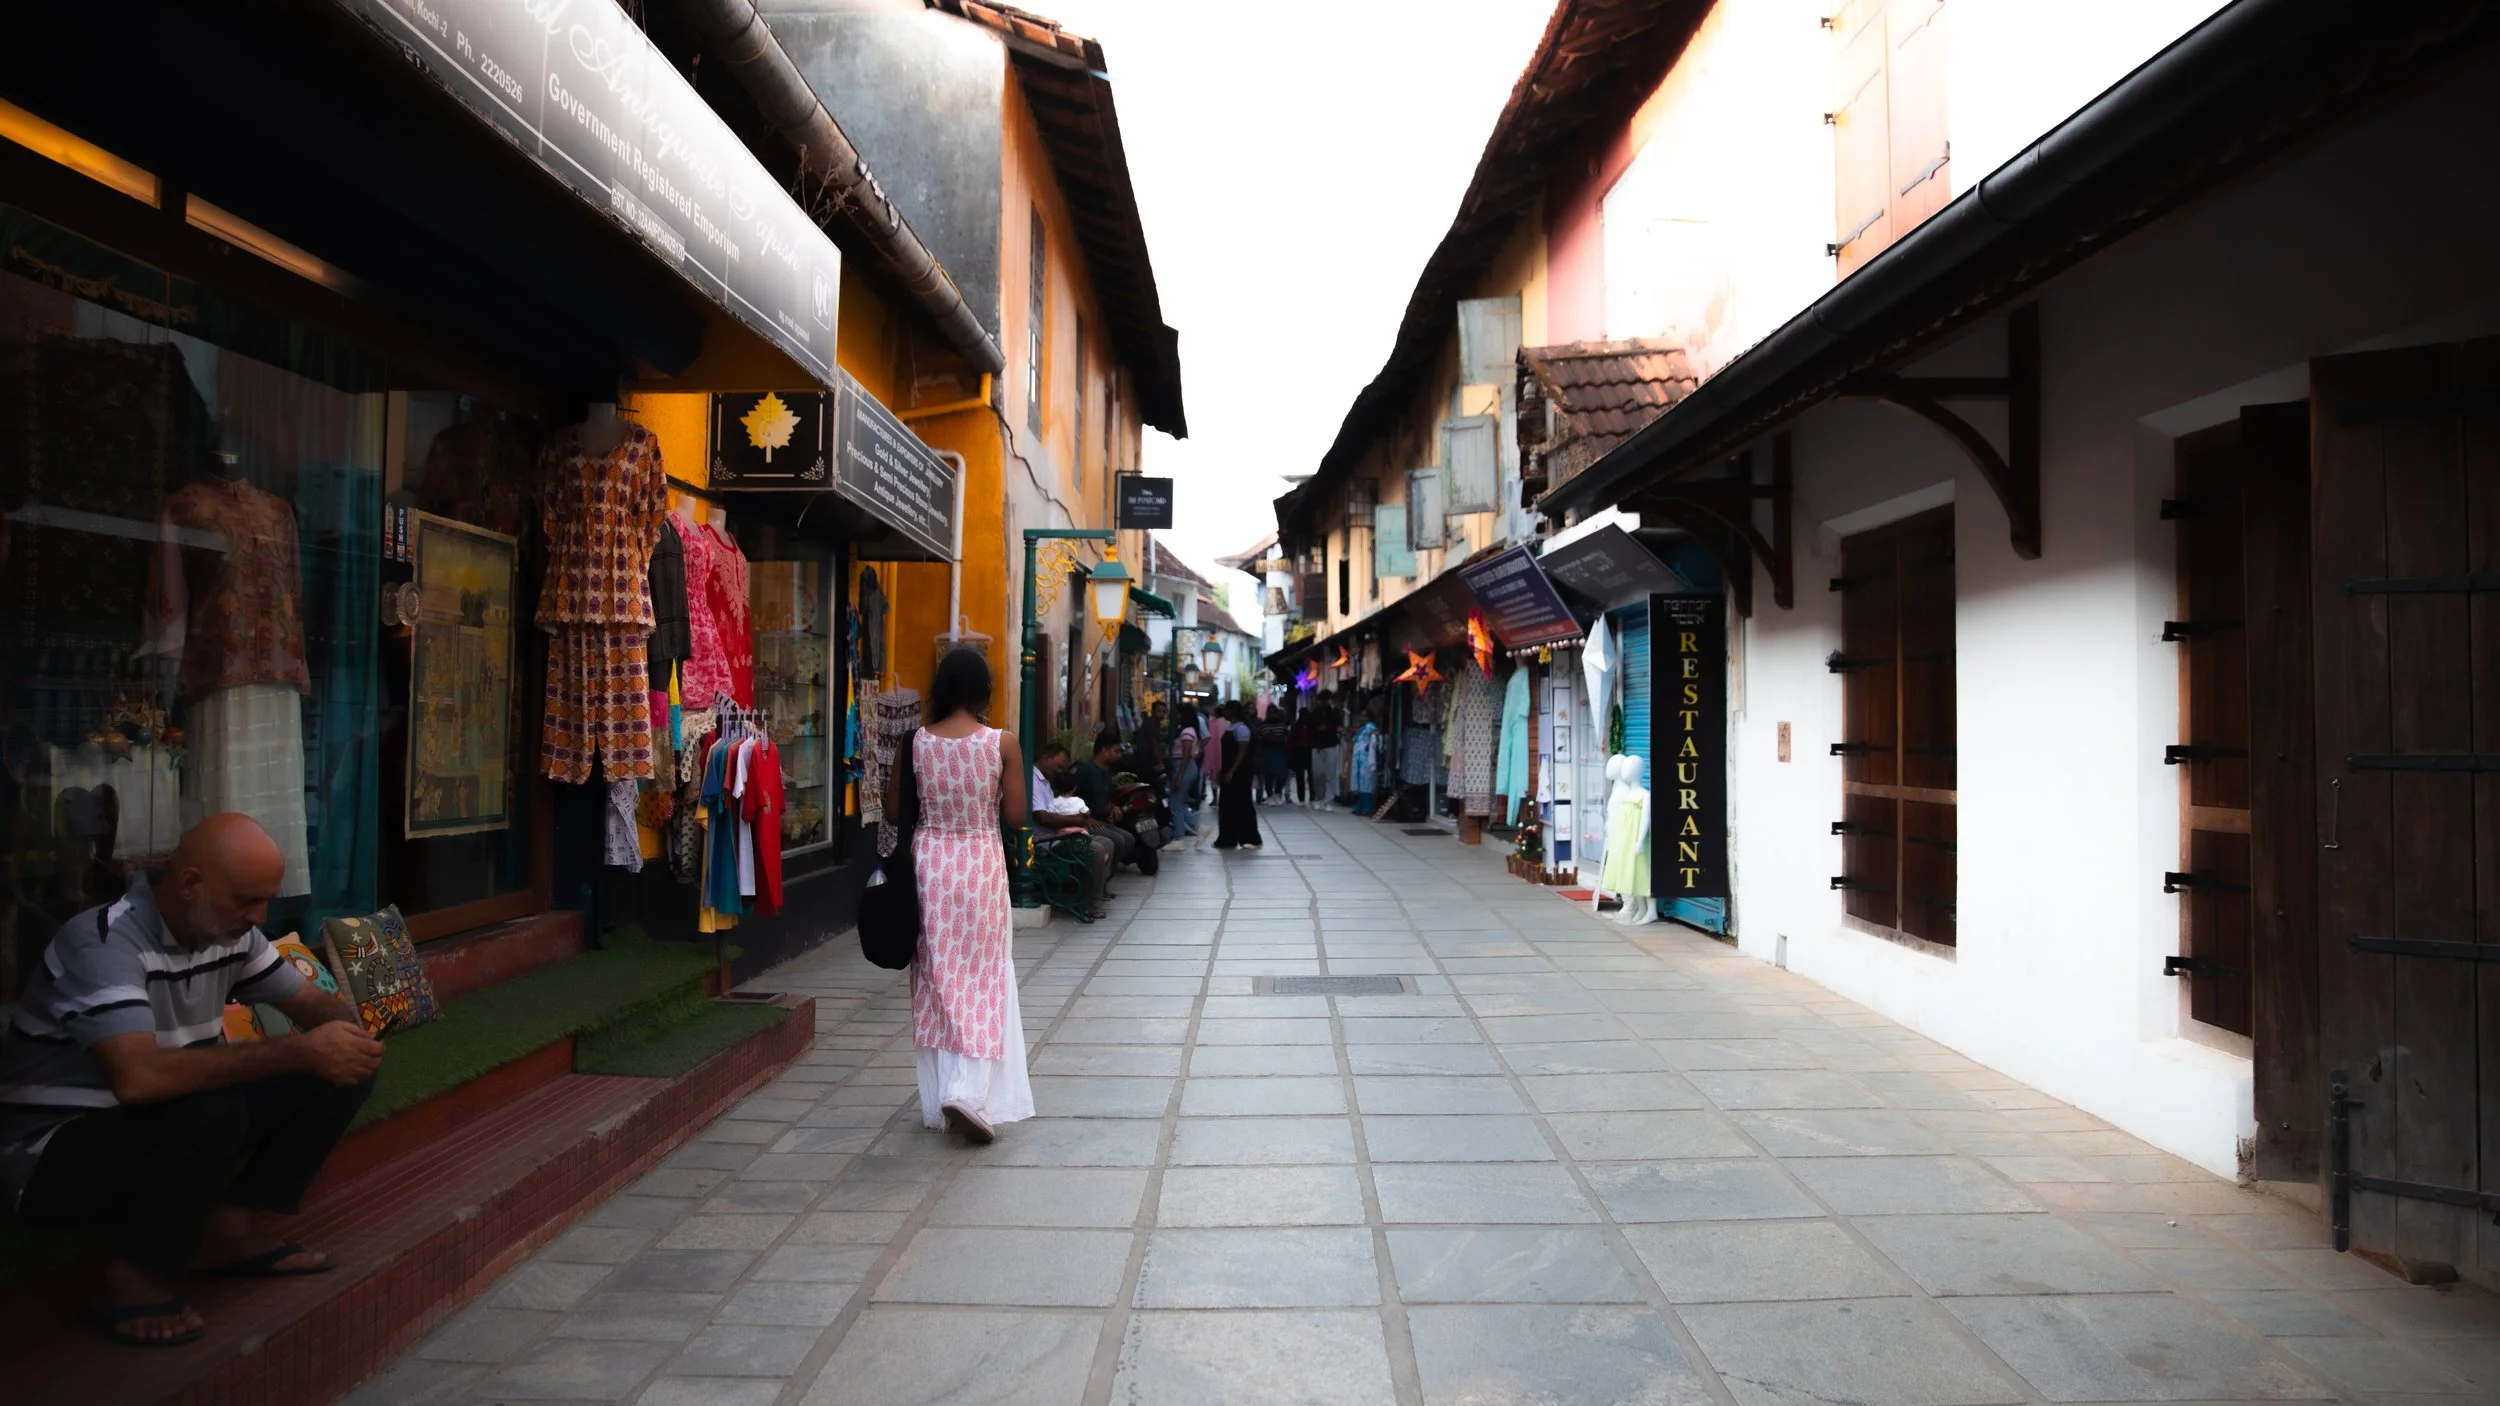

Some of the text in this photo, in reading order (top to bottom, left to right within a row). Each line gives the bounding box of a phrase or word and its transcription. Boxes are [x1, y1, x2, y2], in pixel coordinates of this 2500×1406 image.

[418, 0, 439, 31] Kochi
[456, 31, 523, 103] Ph. 2220526
[549, 72, 740, 263] Government Registered Emporium
[611, 187, 625, 213] GST.
[846, 441, 874, 470] Precious
[873, 461, 879, 474] &
[879, 465, 894, 485] Semi
[893, 475, 915, 501] Precious
[874, 443, 889, 463] Gold
[888, 454, 894, 467] &
[894, 458, 909, 478] Silver
[873, 481, 896, 504] Antique
[1676, 631, 1701, 889] RESTAURANT
